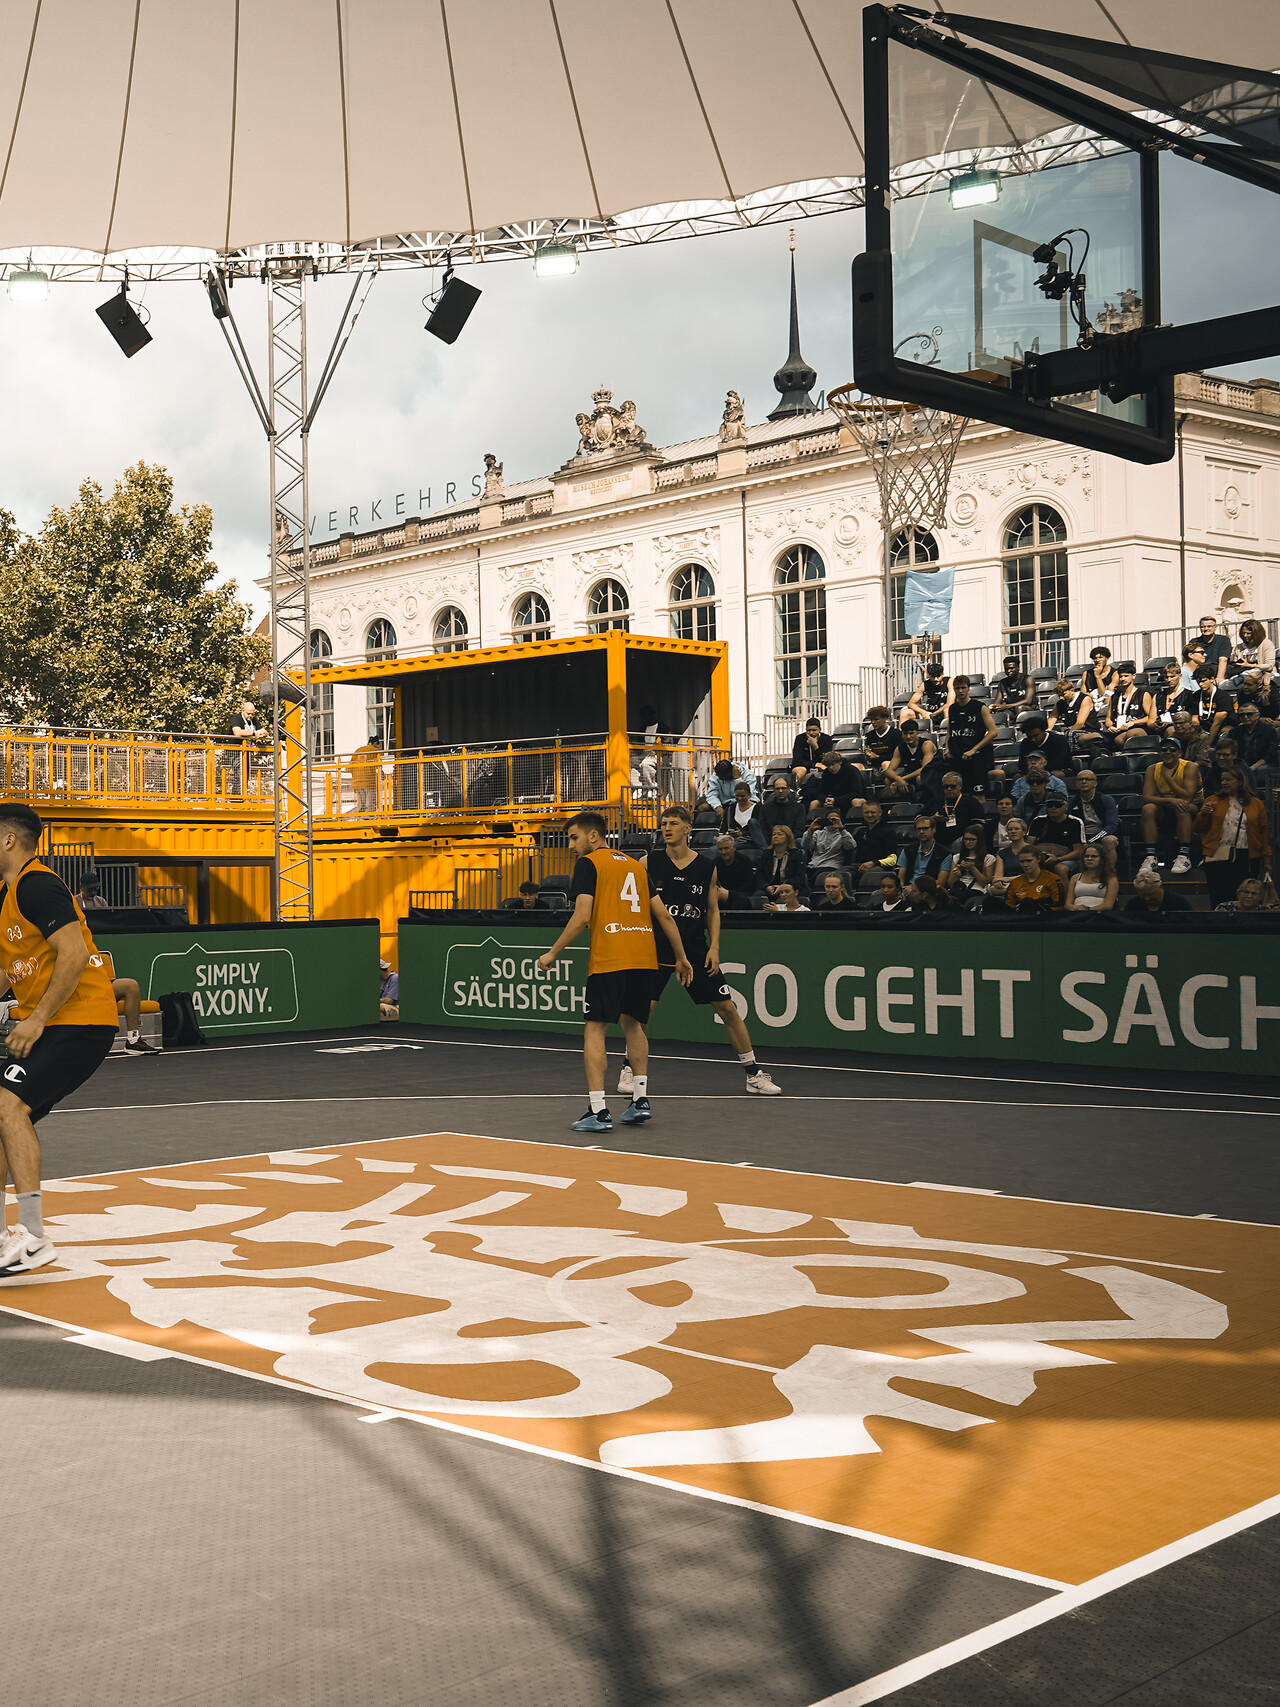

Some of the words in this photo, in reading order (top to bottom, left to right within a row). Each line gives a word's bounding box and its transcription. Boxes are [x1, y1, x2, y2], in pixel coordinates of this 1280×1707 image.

[308, 474, 482, 536] VERKEHRS
[620, 872, 641, 913] 4
[196, 962, 261, 987] SIMPLY
[490, 957, 516, 980] SO
[521, 959, 573, 982] GEHT
[192, 987, 272, 1017] AXONY.
[824, 965, 1031, 1038] GEHT
